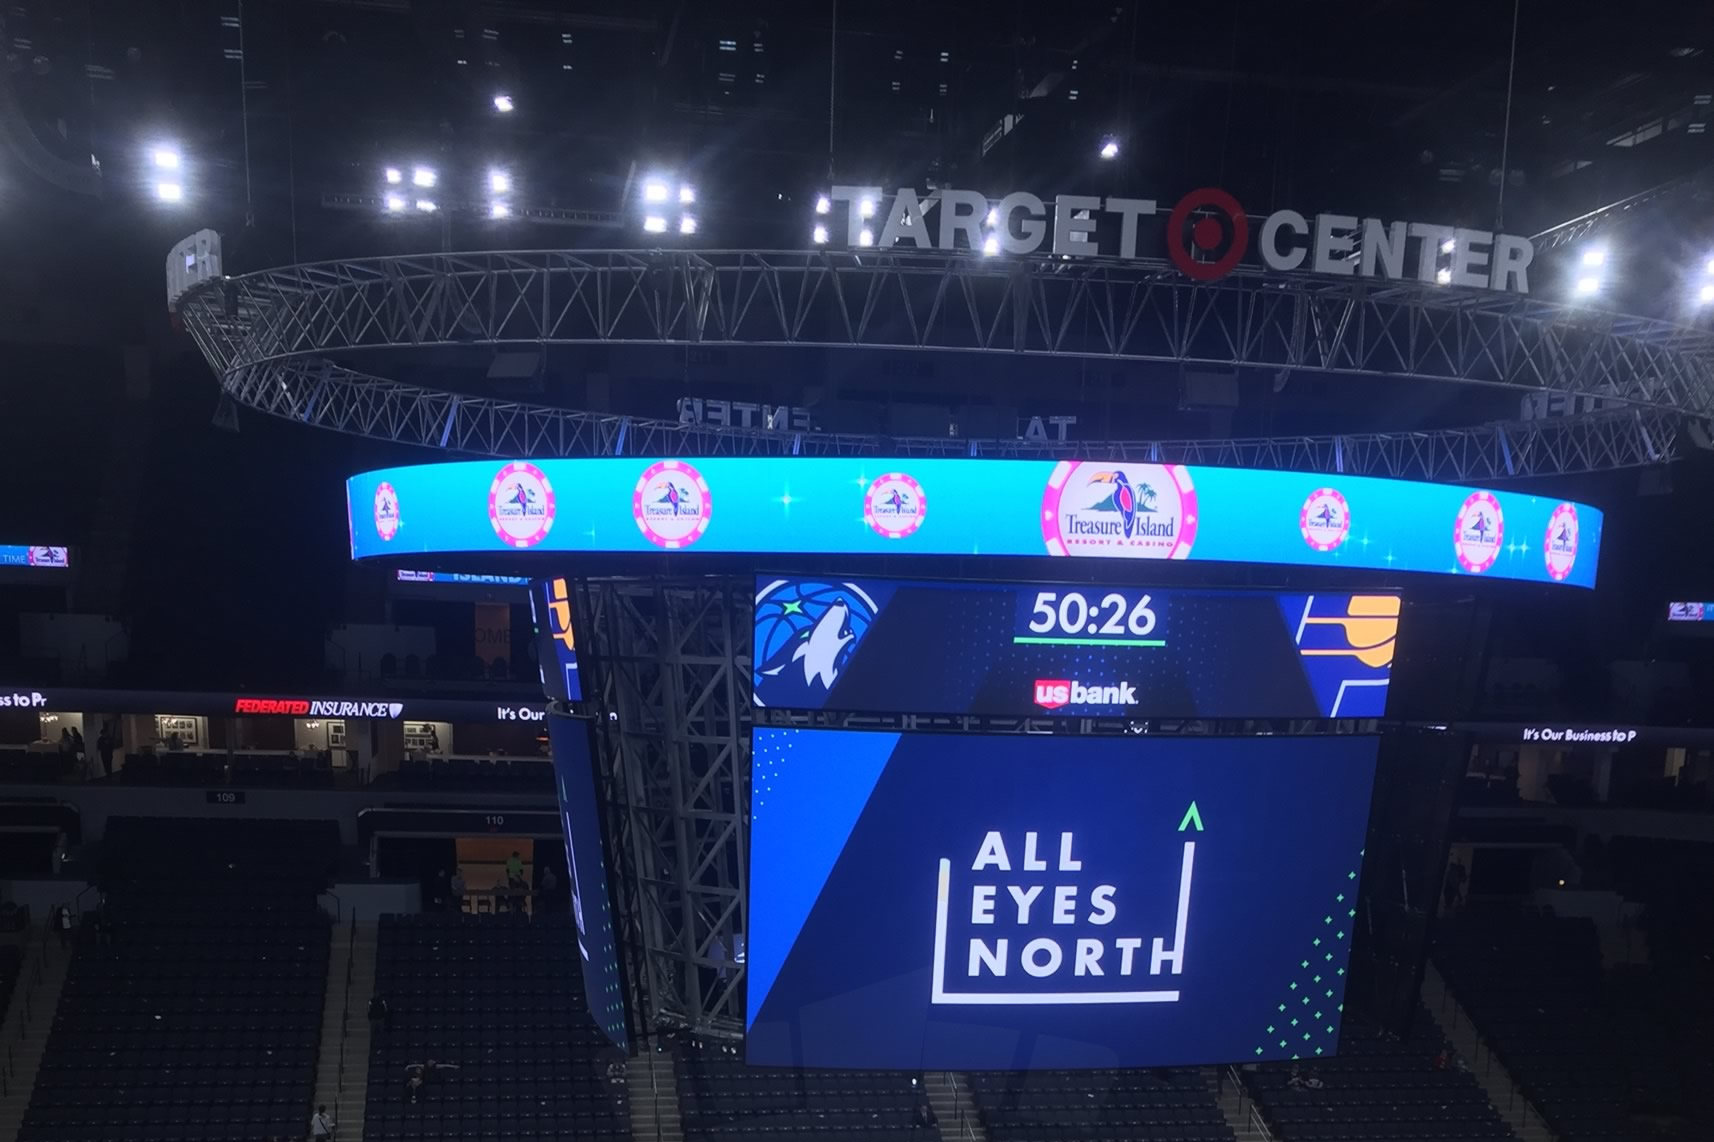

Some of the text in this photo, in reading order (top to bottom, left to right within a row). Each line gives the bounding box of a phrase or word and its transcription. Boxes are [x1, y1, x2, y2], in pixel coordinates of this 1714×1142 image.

[831, 185, 1535, 294] TARGET CENTER
[1066, 514, 1174, 537] Treasure Island
[3, 555, 26, 564] TIME
[1029, 592, 1157, 635] 50:26
[13, 693, 30, 707] to
[32, 692, 47, 707] Pr
[235, 699, 388, 717] FEDERATED INSURANCE
[497, 707, 545, 721] It's Our
[1523, 728, 1540, 740] It's
[1541, 728, 1564, 741] Our
[1565, 729, 1612, 741] Business
[1612, 729, 1627, 742] to
[216, 793, 236, 802] 109
[485, 815, 504, 825] 110
[971, 831, 1082, 871] ALL
[971, 885, 1117, 925] EYES
[968, 937, 1183, 977] NORTH
